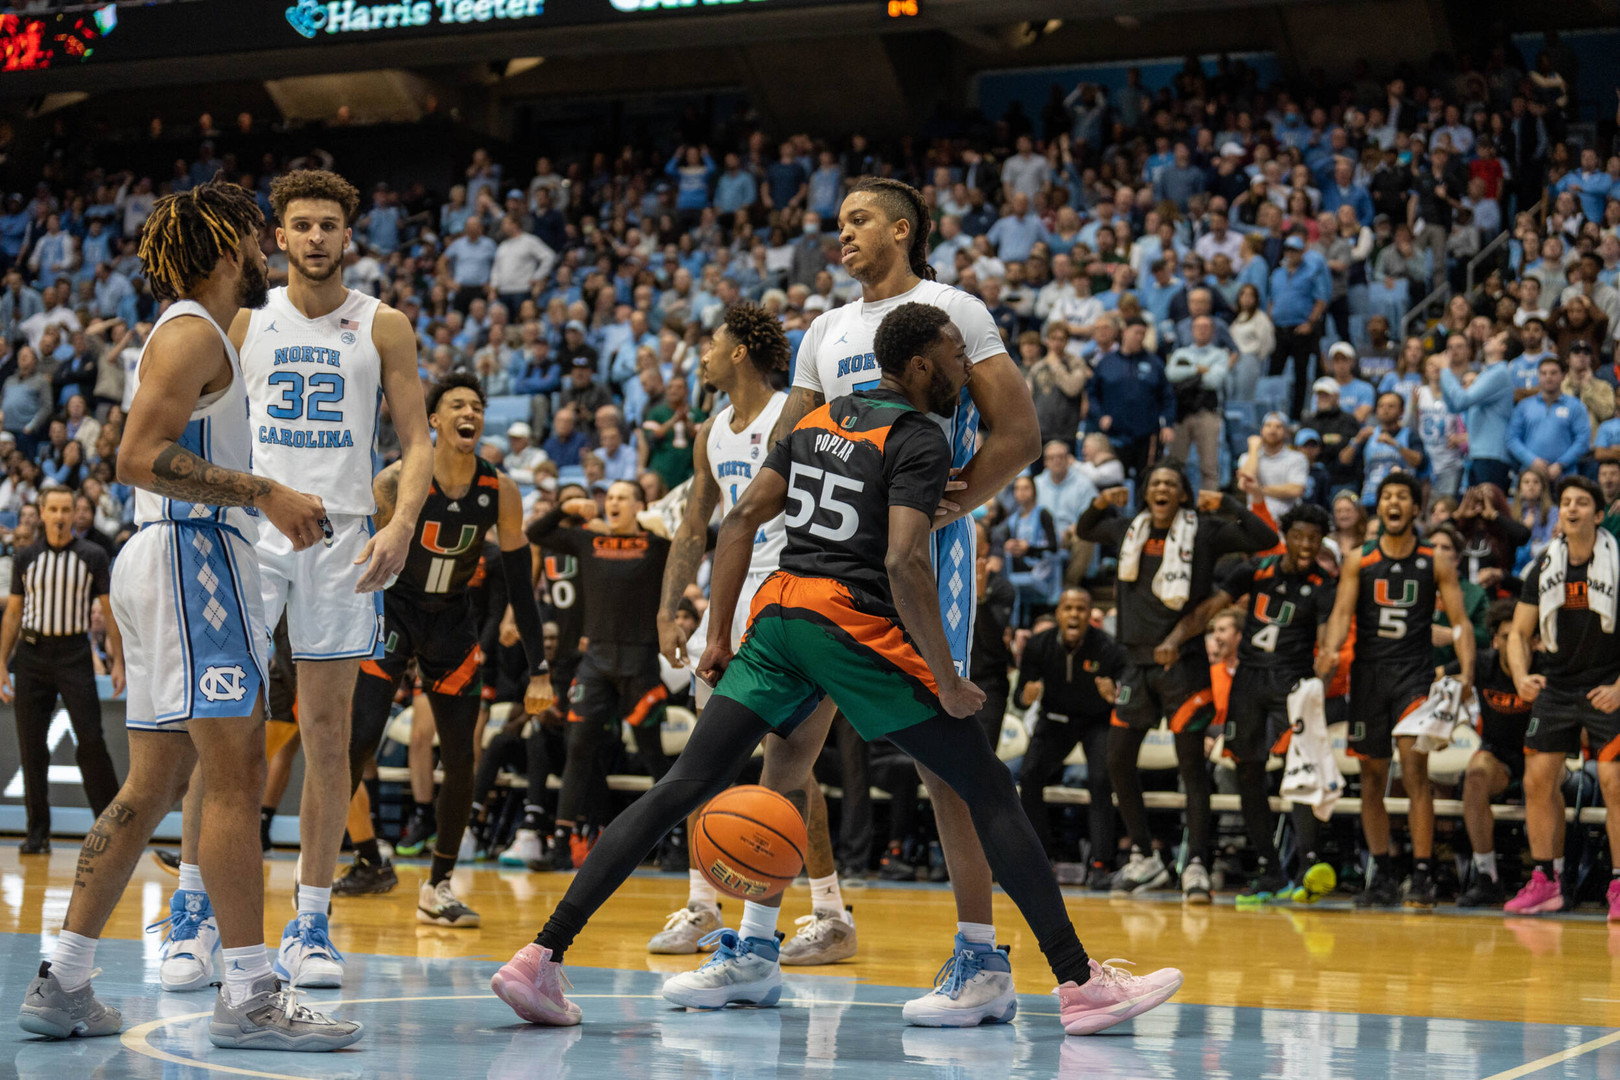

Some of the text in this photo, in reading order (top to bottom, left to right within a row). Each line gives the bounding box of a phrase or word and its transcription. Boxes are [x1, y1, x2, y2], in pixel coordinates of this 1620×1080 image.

[325, 0, 544, 33] Harris Teeter
[274, 346, 340, 367] NORTH
[837, 352, 881, 378] NOR
[267, 371, 344, 422] 32
[260, 426, 353, 448] CAROLINA
[815, 434, 854, 462] POPLAR
[717, 461, 752, 479] NORTH
[785, 461, 864, 541] 55
[421, 520, 477, 555] U
[544, 555, 578, 580] U
[1374, 579, 1418, 607] U
[1254, 592, 1296, 626] U
[1251, 624, 1280, 653] 4
[1377, 608, 1407, 640] 5
[711, 861, 768, 895] ELITE
